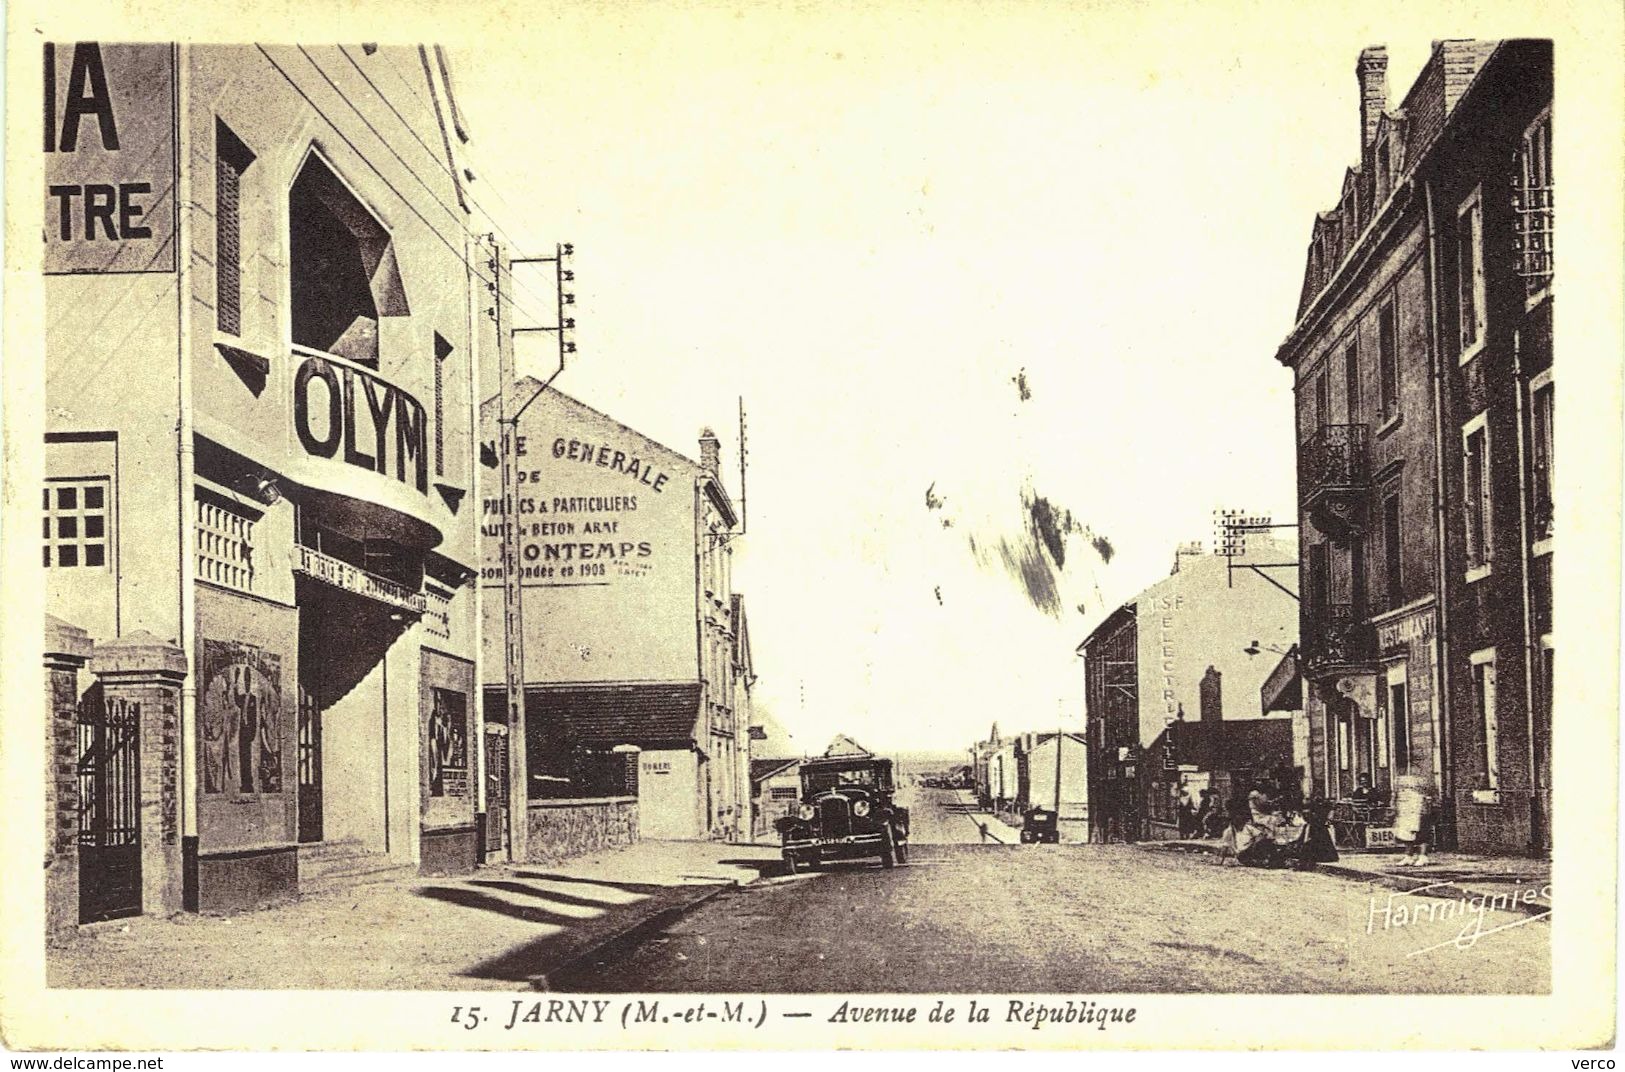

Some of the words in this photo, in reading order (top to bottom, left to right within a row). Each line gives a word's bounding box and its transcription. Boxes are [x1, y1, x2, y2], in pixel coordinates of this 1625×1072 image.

[44, 183, 152, 242] TRE
[294, 356, 428, 497] OLYM
[483, 498, 535, 515] PUCS
[553, 496, 638, 513] PARTICULIERS
[580, 563, 606, 577] 1908
